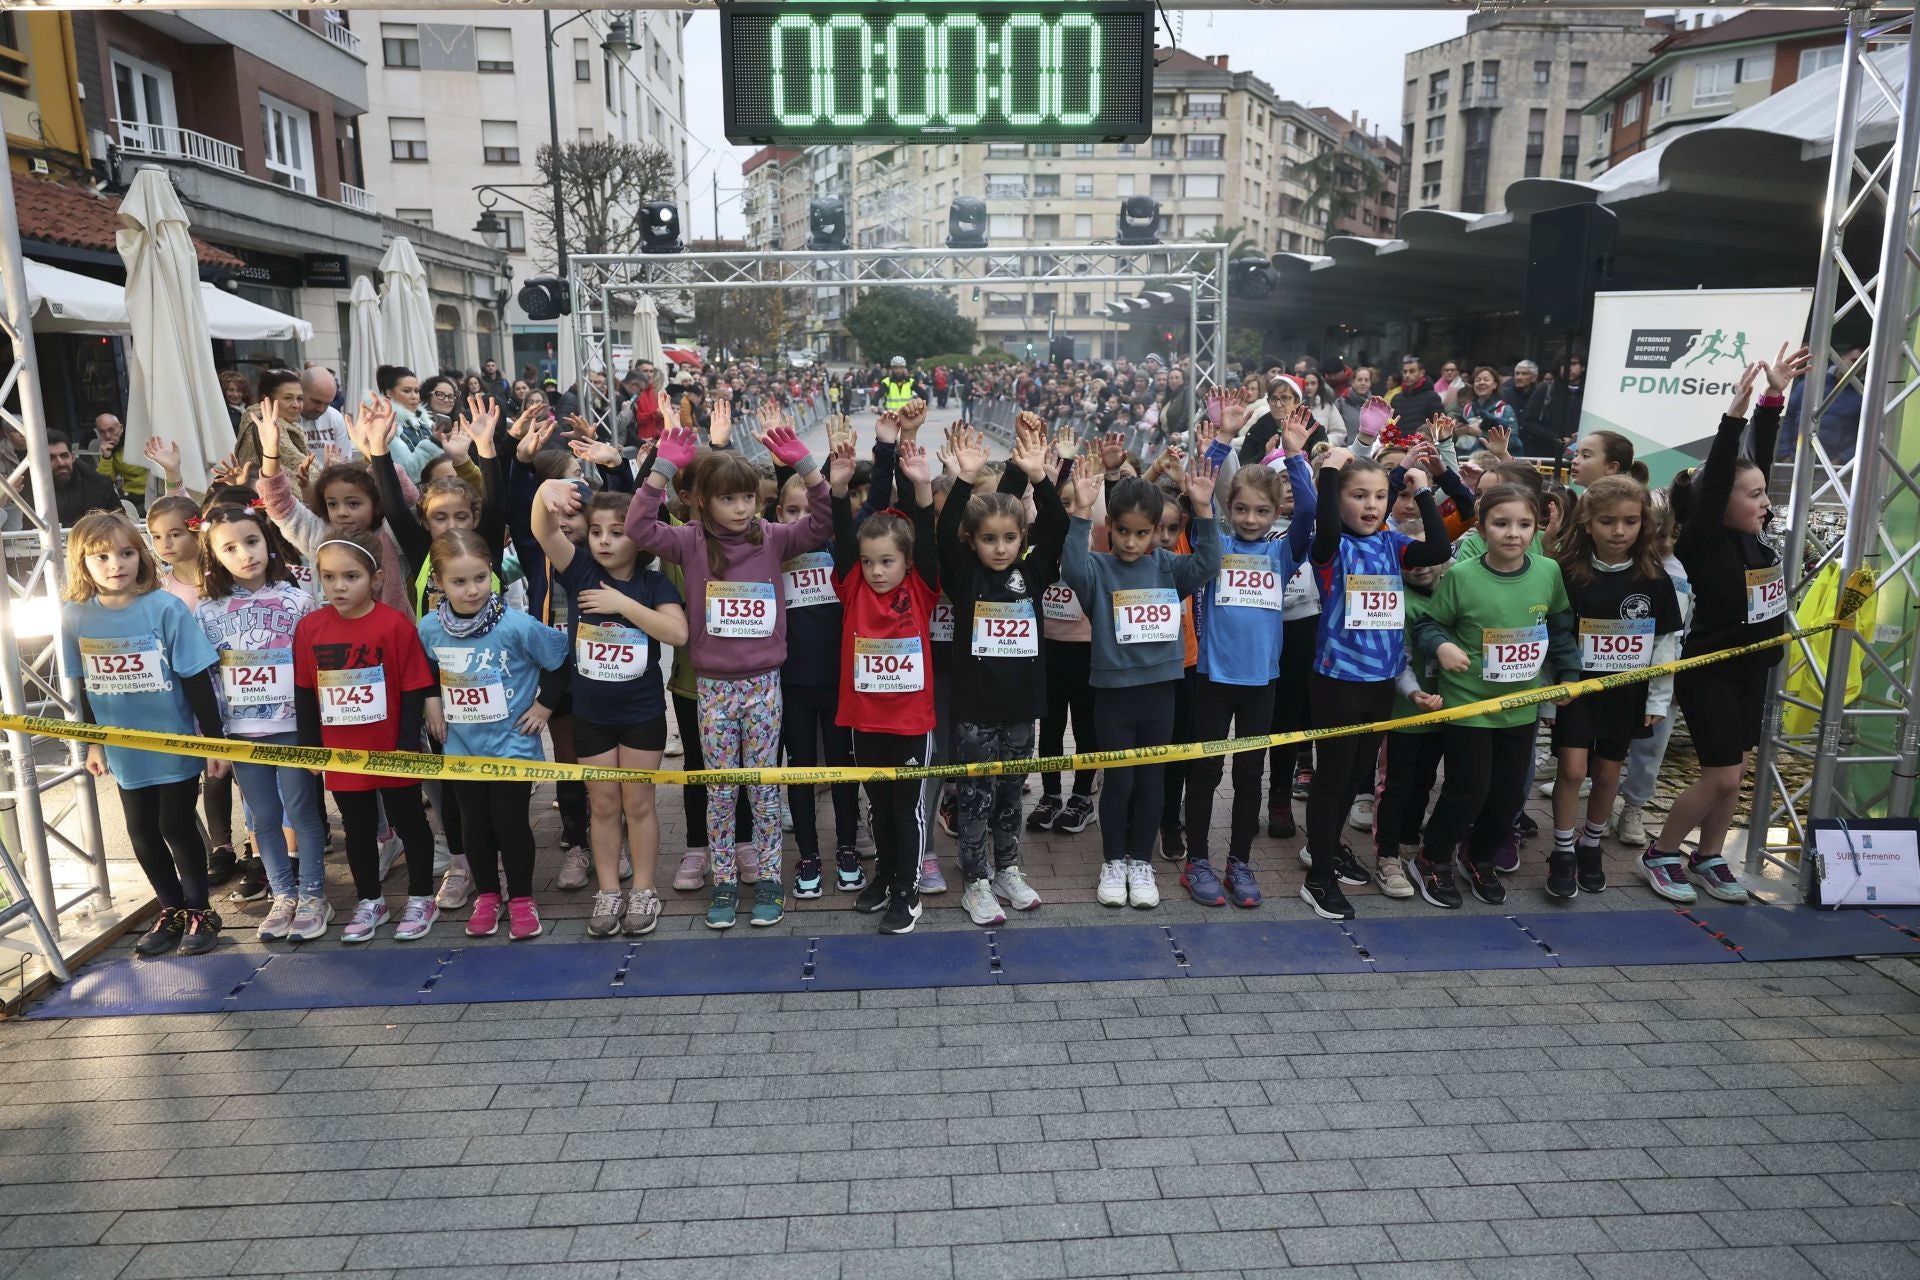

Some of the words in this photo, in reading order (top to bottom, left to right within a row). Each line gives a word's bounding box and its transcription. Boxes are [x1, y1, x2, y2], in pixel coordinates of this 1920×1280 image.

[772, 13, 1101, 126] 00:00:00
[288, 566, 312, 582] 35
[790, 568, 826, 588] 1311
[1226, 570, 1274, 590] 1280
[1349, 578, 1376, 587] Carrera
[708, 585, 737, 594] Carrera
[738, 584, 750, 593] Fin
[750, 585, 758, 593] de
[1239, 588, 1262, 596] DIANA
[802, 594, 838, 604] PDMSiero
[1116, 594, 1142, 602] Carrera
[1144, 592, 1154, 600] Fin
[1360, 592, 1398, 610] 1319
[1044, 602, 1065, 610] VALERIA
[1240, 597, 1278, 608] PDMSiero
[718, 599, 766, 618] 1338
[978, 605, 1002, 614] Carrera
[1003, 604, 1016, 613] Fin
[1124, 605, 1172, 624] 1289
[984, 619, 1030, 638] 1322
[1140, 624, 1160, 632] ELISA
[1582, 622, 1612, 630] Carrera
[1612, 622, 1624, 630] Fin
[732, 628, 769, 636] PDMSiero
[1142, 632, 1175, 640] PDMSiero
[1485, 630, 1514, 640] Carrera
[856, 641, 882, 650] Carrera
[1590, 636, 1644, 653] 1305
[586, 642, 634, 663] 1275
[997, 647, 1033, 655] PDMSiero
[1495, 642, 1540, 663] 1285
[91, 654, 145, 674] 1323
[598, 662, 620, 670] JULIA
[864, 655, 914, 673] 1304
[1501, 662, 1536, 671] CAYETANA
[1605, 662, 1648, 670] PDMSiero
[228, 666, 277, 686] 1241
[598, 672, 638, 680] PDMSiero
[1510, 670, 1538, 680] PDMSie
[110, 682, 156, 691] PDMSiero
[242, 694, 288, 703] PDMSiero
[326, 685, 374, 706] 1243
[447, 688, 490, 706] 1281
[1510, 686, 1566, 708] AMBIENTE
[342, 714, 382, 722] PDMSiero
[164, 739, 178, 747] DE
[181, 740, 231, 753] ASTURIAS
[1204, 737, 1270, 752] COMPROMETIDOS
[252, 752, 315, 764] RECICLADO
[284, 748, 329, 760] MATERIAL
[480, 764, 518, 777] CAJA
[524, 767, 577, 780] RURAL
[1004, 760, 1071, 774] FABRICADO
[700, 772, 759, 782] RECICLADO
[781, 773, 826, 781] ASTURIAS
[1863, 852, 1901, 860] Femenino
